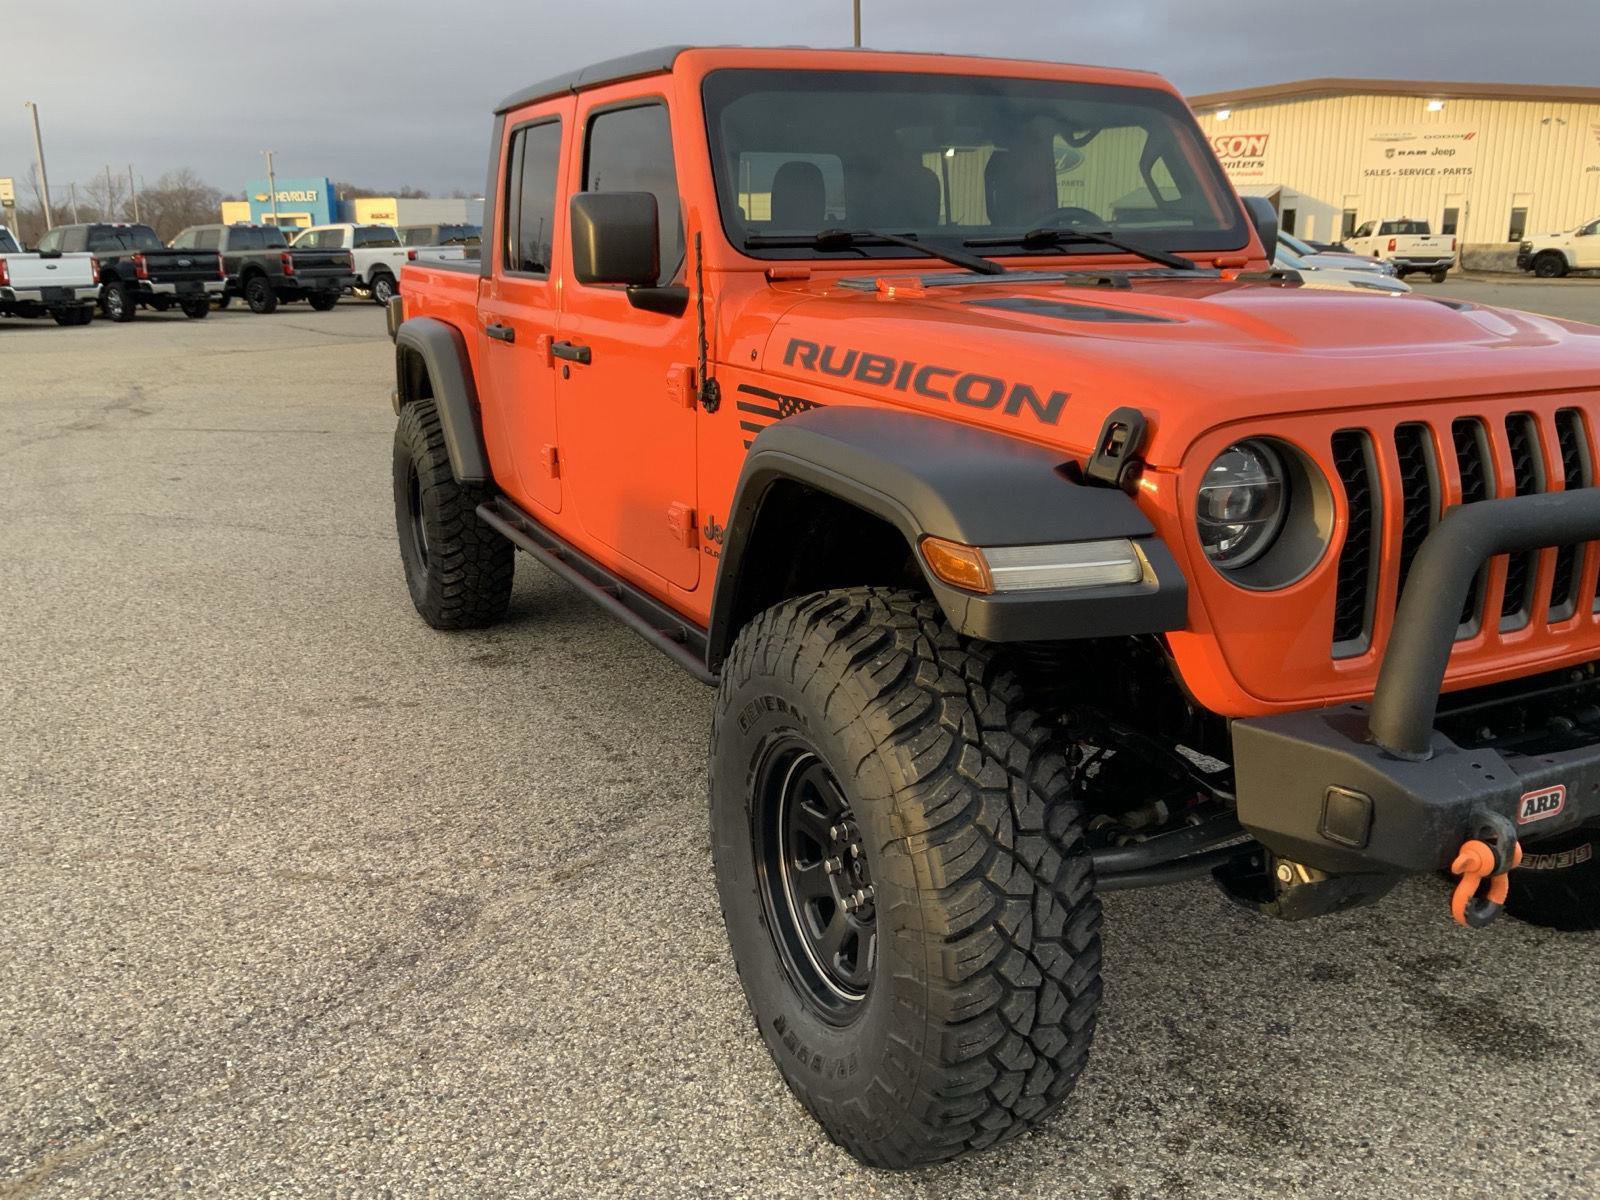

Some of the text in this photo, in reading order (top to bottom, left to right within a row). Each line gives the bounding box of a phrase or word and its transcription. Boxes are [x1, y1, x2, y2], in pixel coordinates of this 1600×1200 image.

[1208, 134, 1269, 158] SON
[1431, 147, 1456, 156] Jeep
[1221, 160, 1265, 169] enters
[1364, 167, 1473, 177] SALES SERVICE PARTS
[269, 190, 319, 203] HEVROLET
[781, 337, 1072, 426] RUBICON
[1523, 791, 1560, 818] ARB
[1517, 842, 1592, 870] GENE
